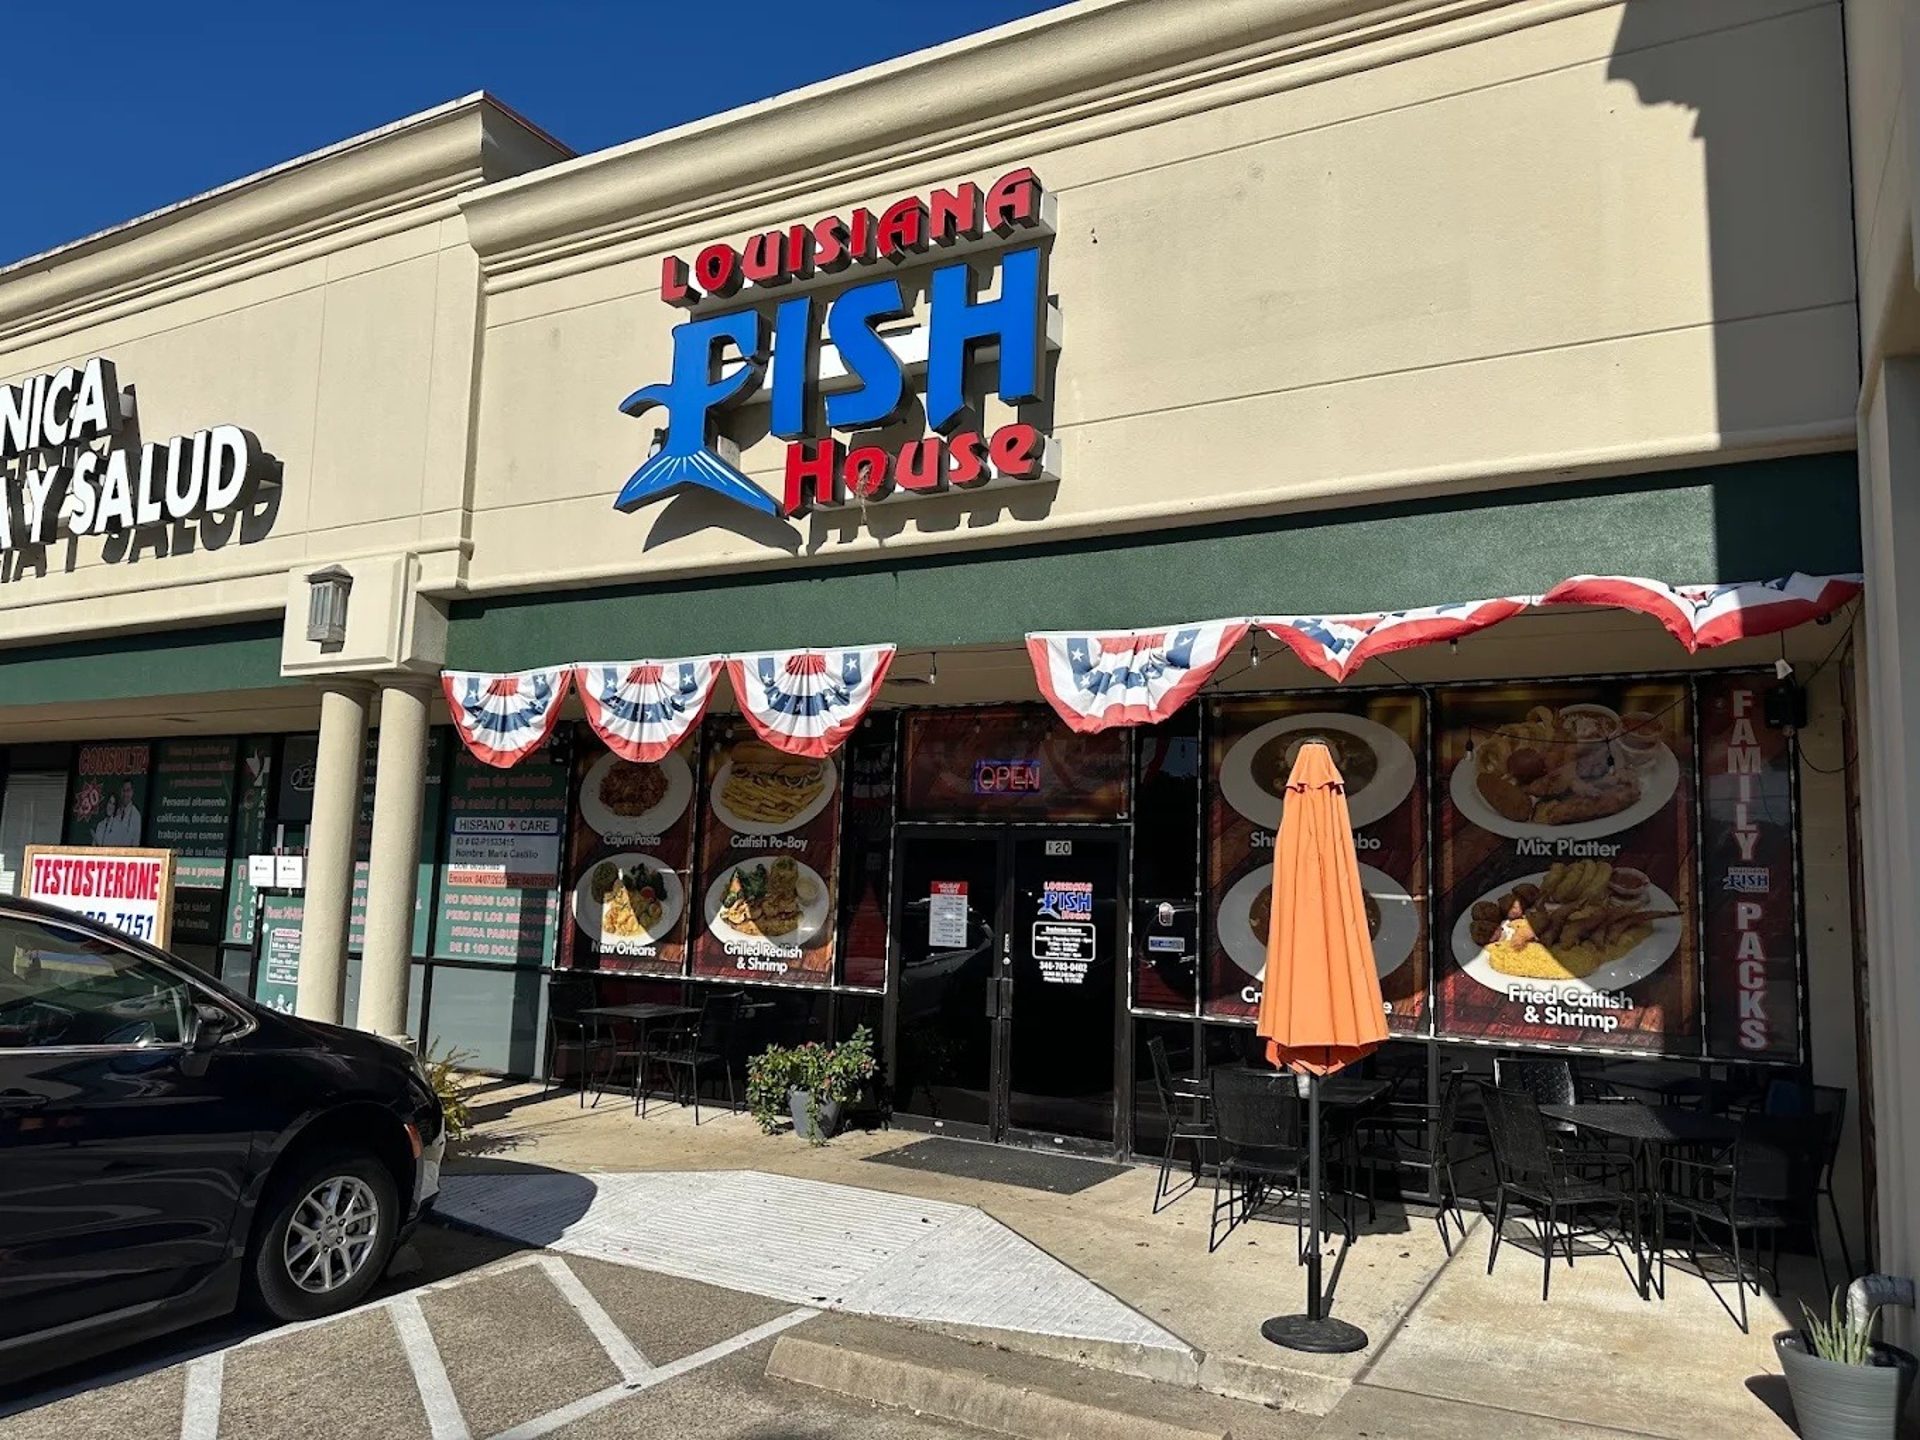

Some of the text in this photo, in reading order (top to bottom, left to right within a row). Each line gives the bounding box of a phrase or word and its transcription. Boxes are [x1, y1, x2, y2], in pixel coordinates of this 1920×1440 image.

[661, 167, 1042, 301] LOUISIANA
[614, 247, 1041, 517] FISH
[26, 465, 60, 543] Y
[68, 423, 249, 535] SALUD
[79, 746, 149, 776] CONSULTA
[979, 767, 1040, 790] OPEN
[1726, 689, 1762, 860] FAMILY
[459, 819, 550, 832] HISPANO CARE
[603, 832, 661, 849] Cajun Pasta
[730, 835, 808, 851] Catfish Po-Boy
[1516, 839, 1620, 858] Mix Platter
[34, 859, 160, 900] TESTOSTERONE
[445, 892, 459, 904] NO
[460, 894, 495, 906] SOMOS
[496, 896, 515, 907] LOS
[1037, 892, 1093, 919] FISH
[484, 912, 503, 923] LOS
[449, 941, 462, 953] DE
[472, 942, 490, 955] 100
[617, 943, 656, 957] Orleans
[724, 942, 803, 959] Grilled Redfish
[736, 958, 788, 974] & Shrimp
[1737, 902, 1768, 1050] PACKS
[1508, 984, 1634, 1011] Fried Catfish
[1524, 1007, 1619, 1032] & Shrimp
